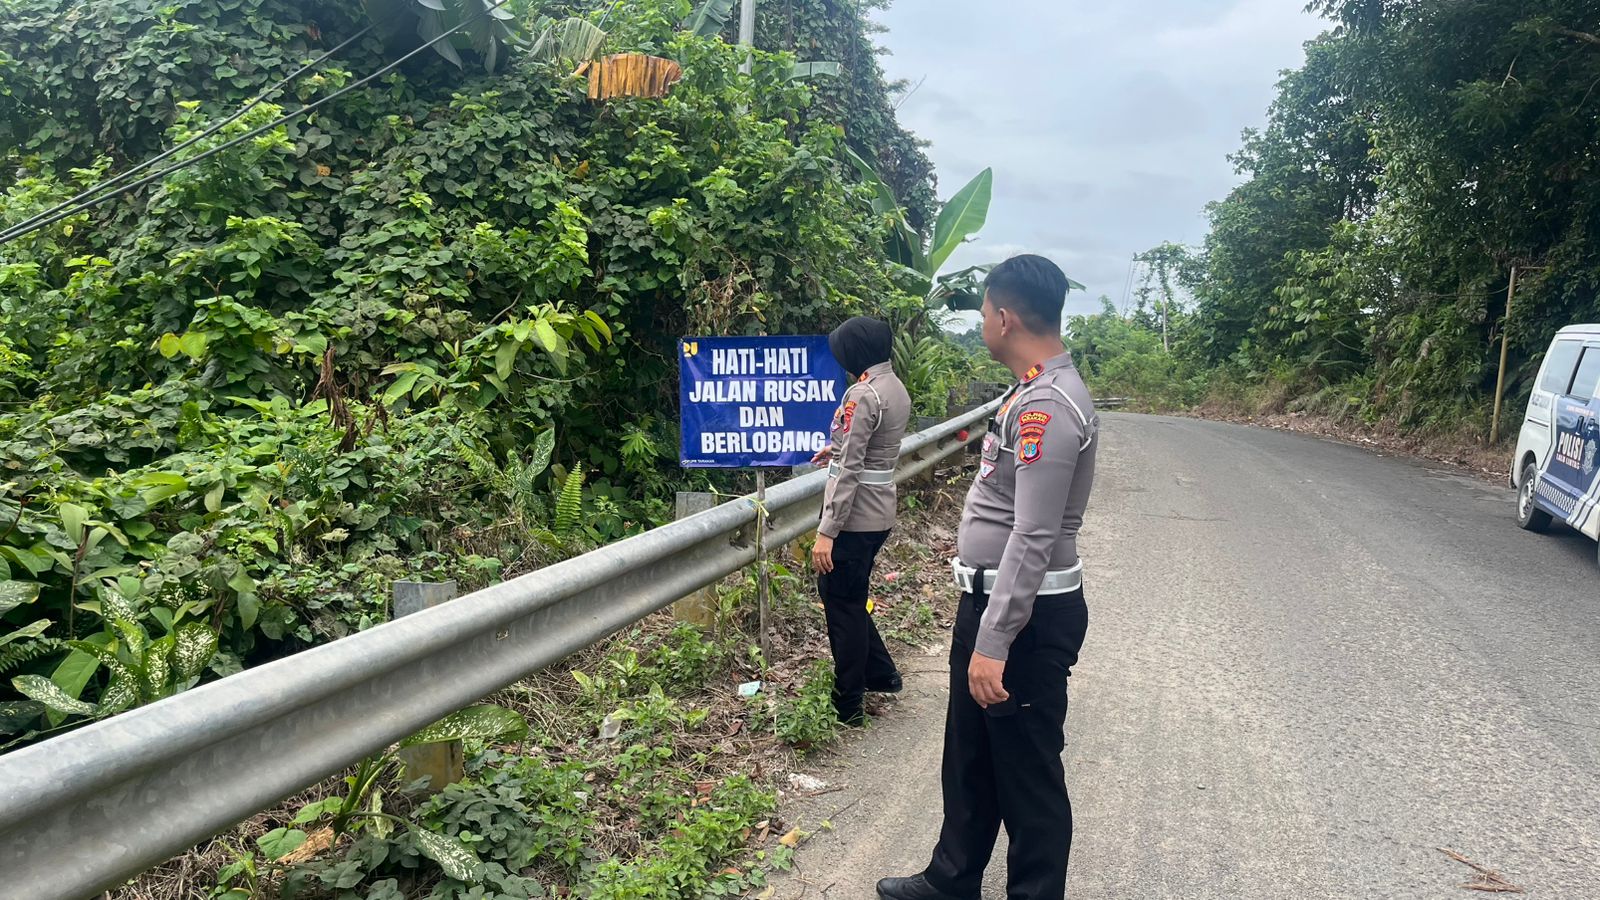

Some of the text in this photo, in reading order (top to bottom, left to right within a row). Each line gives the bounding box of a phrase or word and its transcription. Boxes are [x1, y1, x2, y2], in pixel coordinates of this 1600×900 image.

[712, 348, 807, 375] HATI-HATI
[689, 379, 836, 402] JALAN RUSAK
[739, 406, 784, 428] DAN
[701, 430, 826, 454] BERLOBANG
[1557, 431, 1585, 461] POLISI
